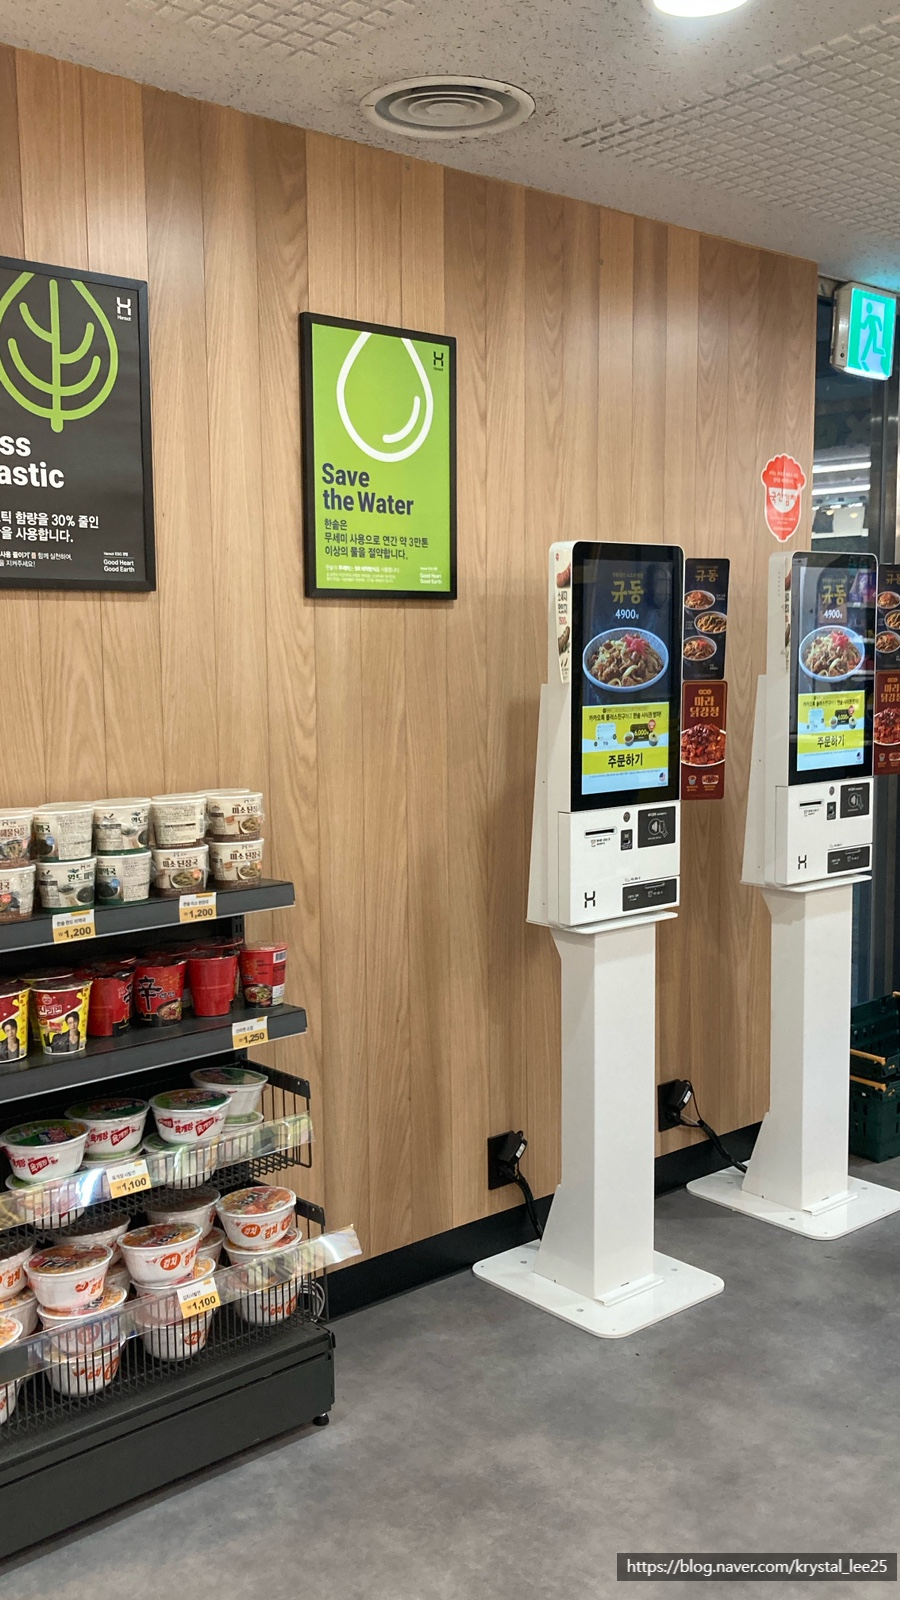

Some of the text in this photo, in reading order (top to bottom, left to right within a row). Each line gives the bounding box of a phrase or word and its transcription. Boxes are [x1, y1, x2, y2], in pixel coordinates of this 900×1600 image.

[322, 463, 370, 487] Save
[323, 488, 414, 515] the Water
[15, 512, 49, 526] 함량을
[51, 514, 75, 527] 30%
[78, 515, 99, 529] 줄인
[324, 518, 348, 531] 한솥은
[15, 528, 74, 543] 사용합니다.
[324, 532, 429, 549] 무세미 사용으로 연간 약 3만톤
[325, 545, 408, 560] 이상의 물을 절약합니다.
[695, 569, 719, 583] 규동
[611, 580, 644, 604] 규동
[821, 584, 847, 606] 규동
[817, 735, 845, 748] 주문하기
[608, 752, 643, 768] 주문하기
